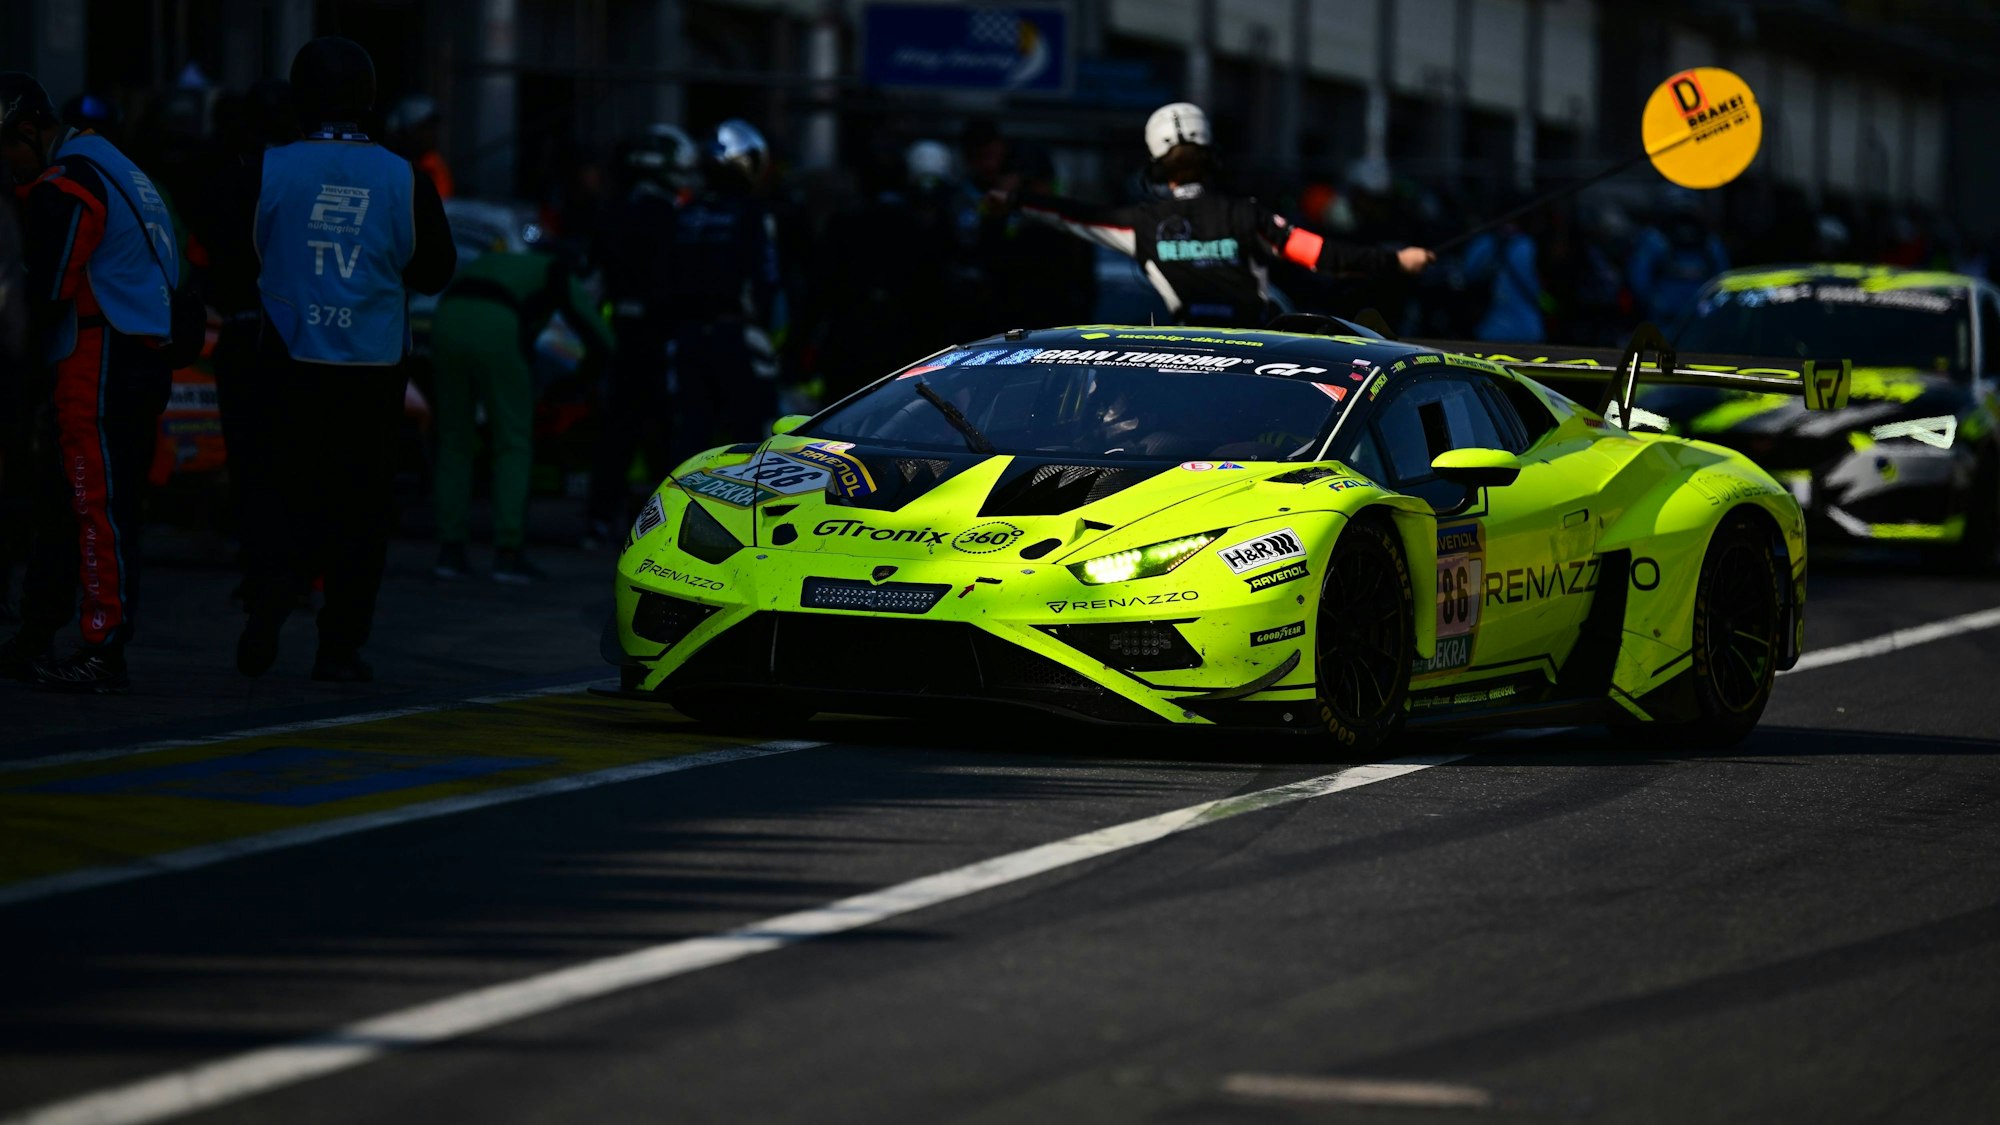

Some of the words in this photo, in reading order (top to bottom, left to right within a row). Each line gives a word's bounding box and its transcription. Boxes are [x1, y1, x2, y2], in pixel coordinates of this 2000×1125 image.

[1672, 79, 1701, 113] D
[307, 221, 361, 236] nürburgring
[306, 240, 362, 279] TV
[306, 303, 352, 328] 378
[1033, 350, 1118, 362] GRAN
[1148, 363, 1225, 372] SIMULATOR
[798, 449, 861, 497] RAVENOL
[699, 479, 764, 506] DEKRA
[812, 519, 951, 545] GTronix
[1223, 542, 1274, 568] H&R
[1437, 538, 1476, 553] VENOL
[648, 565, 725, 591] RENAZZO
[1251, 565, 1306, 589] RAVENOL
[1485, 556, 1661, 607] RENAZZO
[1072, 590, 1200, 610] RENAZZO
[1437, 564, 1469, 625] 86
[1256, 625, 1302, 643] GOODYEAR
